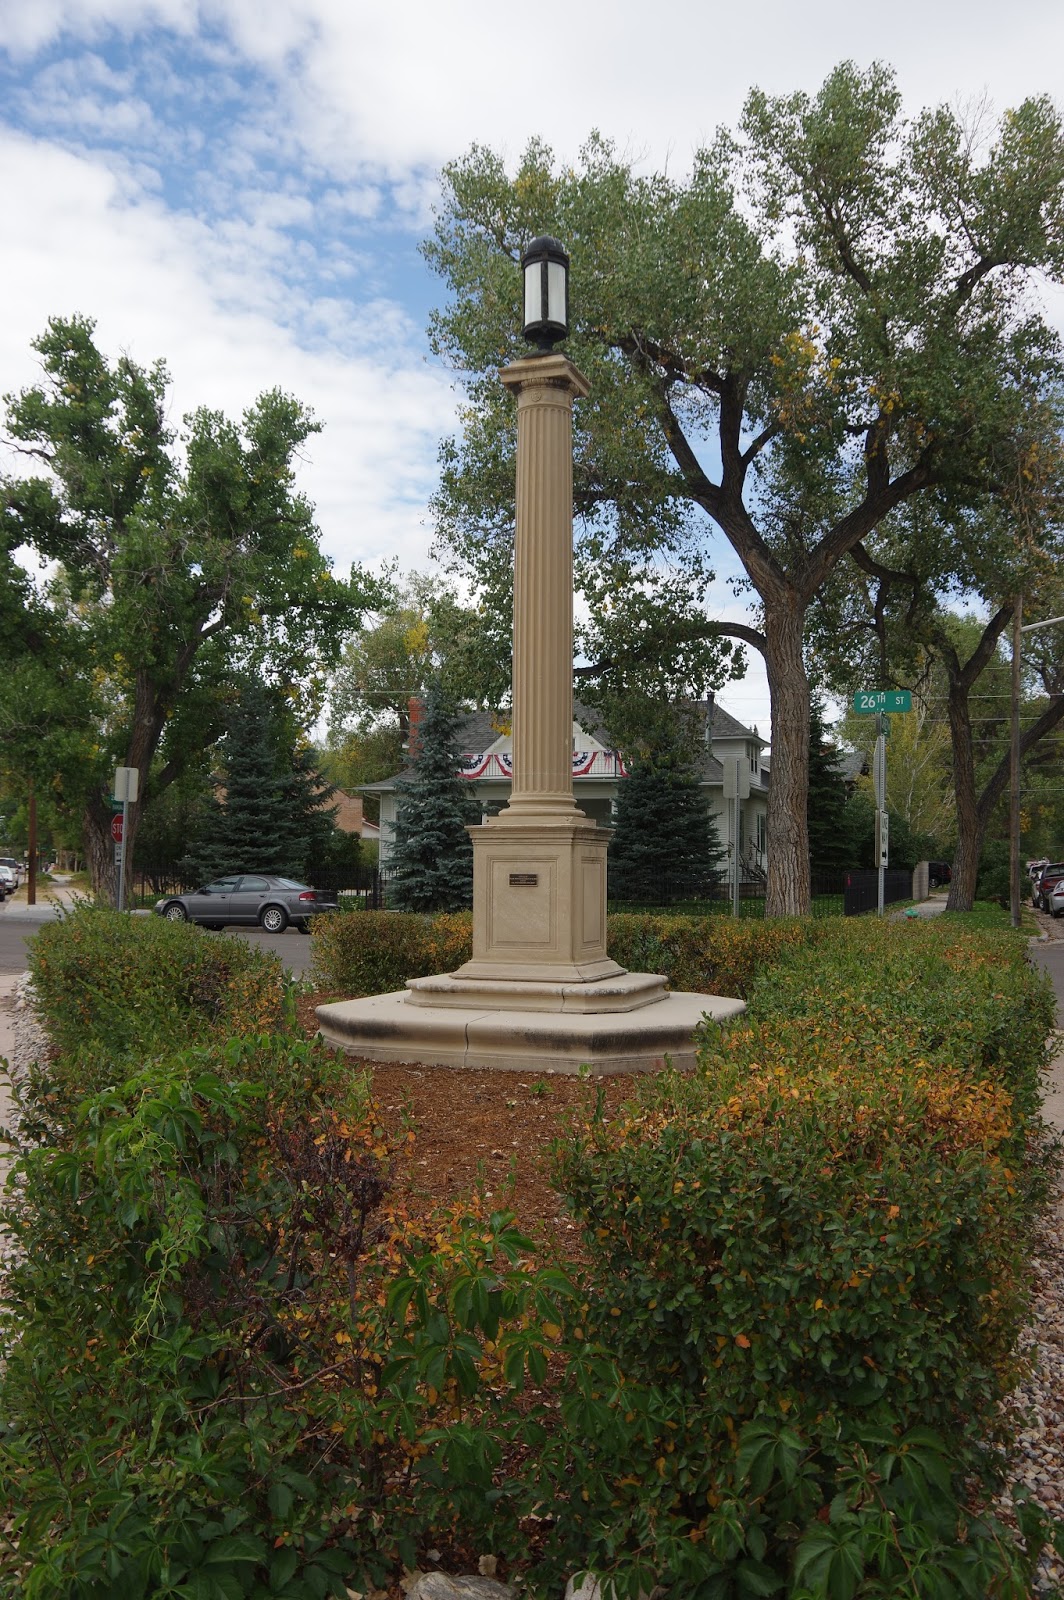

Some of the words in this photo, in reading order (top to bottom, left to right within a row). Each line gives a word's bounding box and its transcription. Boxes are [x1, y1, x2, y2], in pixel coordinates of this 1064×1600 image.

[860, 695, 886, 708] 26TH
[895, 696, 905, 705] ST
[112, 823, 123, 834] STO
